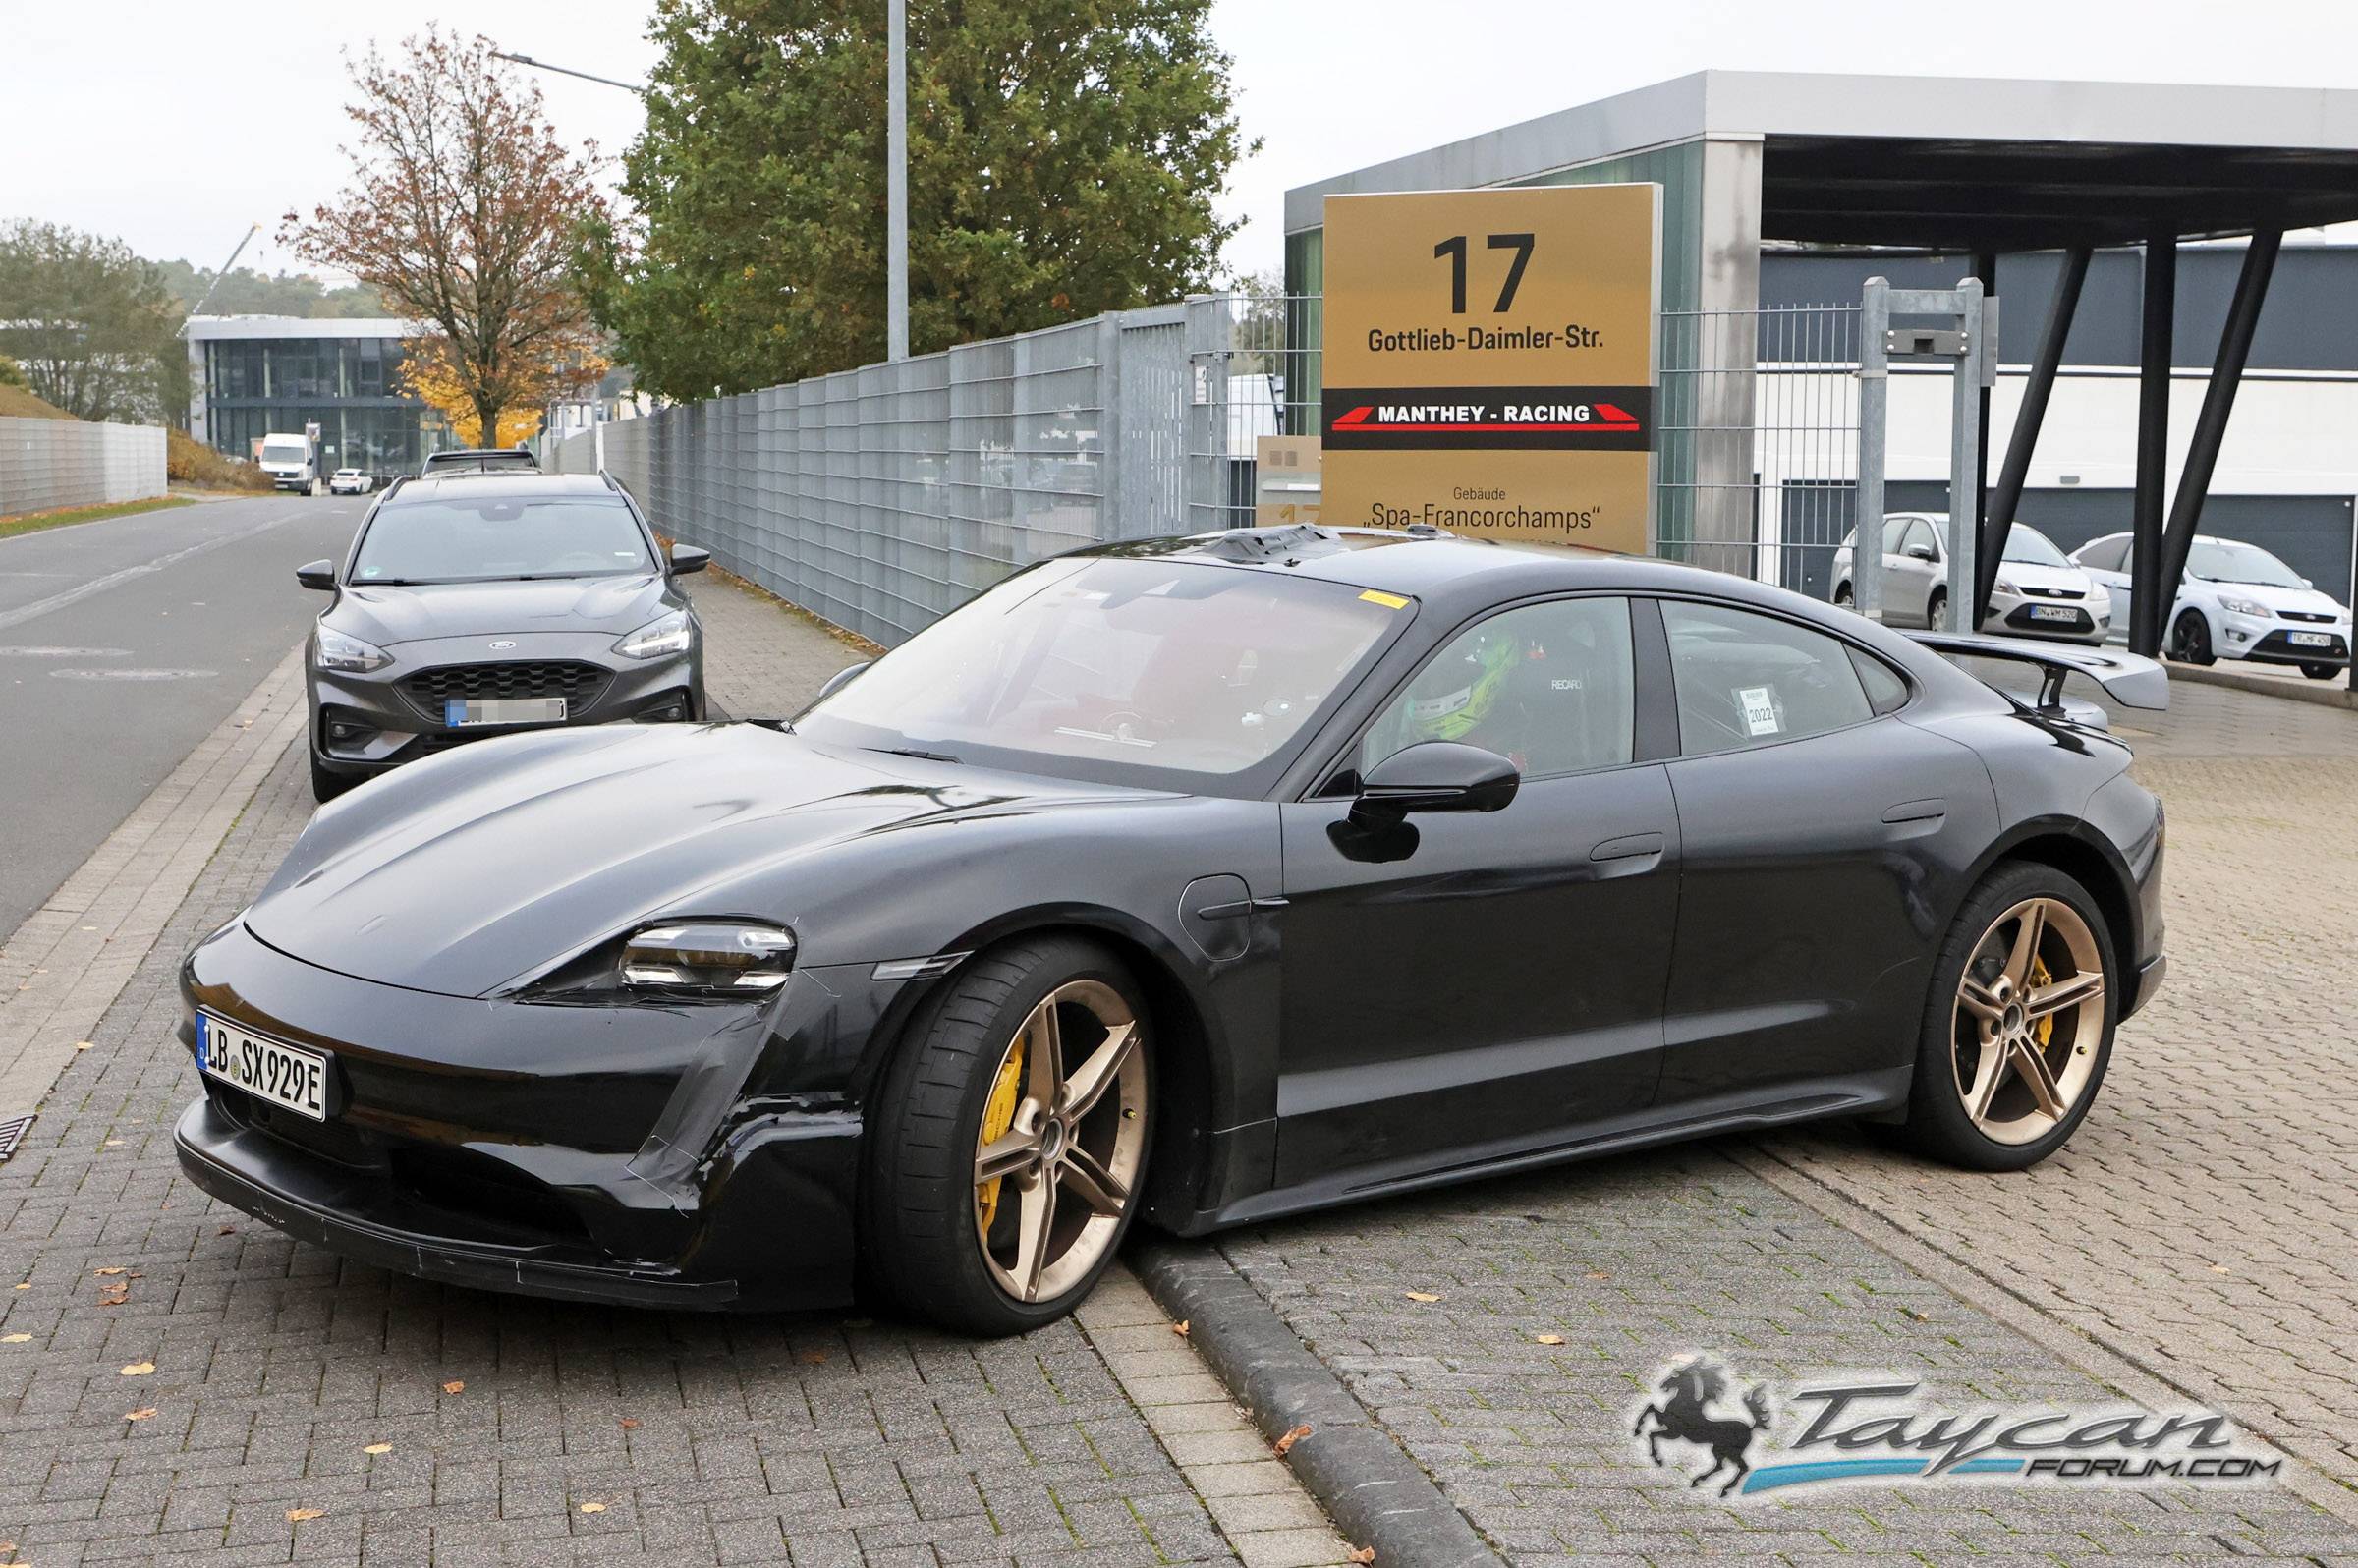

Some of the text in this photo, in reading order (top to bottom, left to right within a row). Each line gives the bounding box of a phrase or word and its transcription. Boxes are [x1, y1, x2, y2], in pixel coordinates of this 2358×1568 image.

[1433, 233, 1535, 314] 17
[1368, 324, 1604, 352] Gottlieb-Daimler-Str.
[1377, 405, 1485, 423] MANTHEY
[1503, 404, 1590, 423] RACING
[1453, 486, 1506, 501] Gebäude
[1749, 707, 1773, 723] 2022
